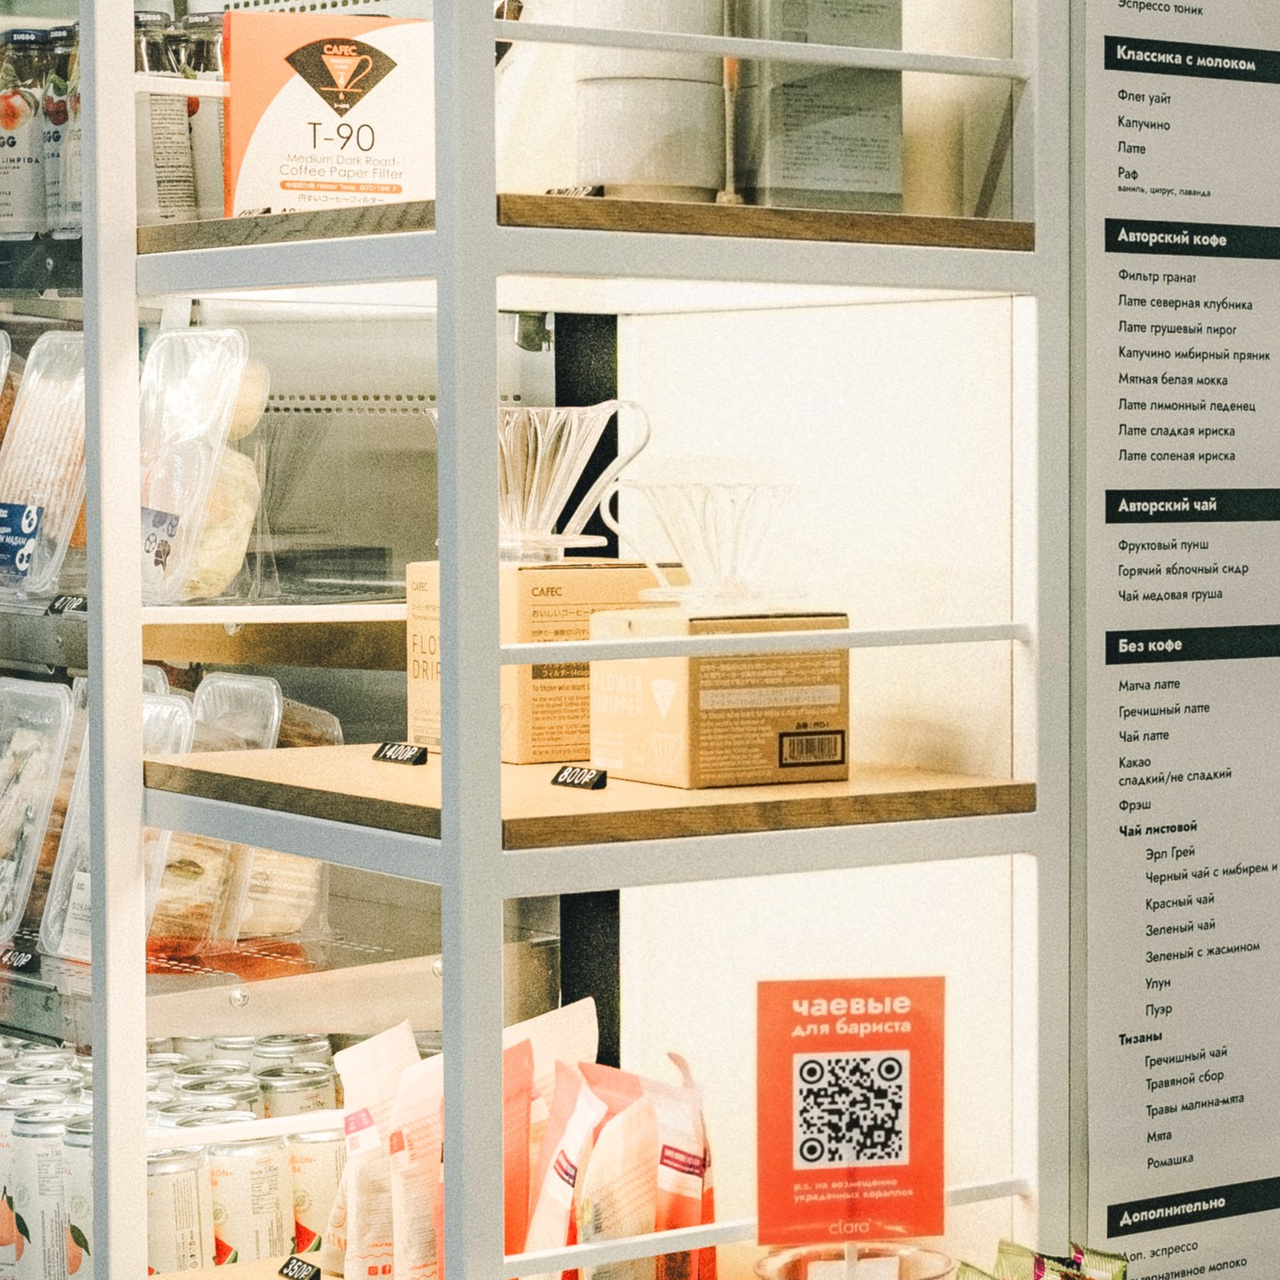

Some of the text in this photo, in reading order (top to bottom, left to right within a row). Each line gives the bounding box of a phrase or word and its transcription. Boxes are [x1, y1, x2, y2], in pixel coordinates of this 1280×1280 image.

[323, 44, 358, 56] CAFEC
[1116, 45, 1183, 65] Классика
[1185, 55, 1193, 66] с
[1196, 56, 1257, 71] молоком
[1117, 88, 1146, 103] Флет
[1148, 92, 1172, 106] уайт
[1117, 115, 1171, 132] Капучино
[307, 121, 375, 152] T-90
[336, 155, 362, 166] Dark
[279, 164, 405, 180] Coffee Paper Filter
[1118, 497, 1190, 514] Авторский
[1193, 497, 1217, 511] чай
[1117, 538, 1178, 554] Фруктовый
[1180, 541, 1210, 553] пунш
[1117, 563, 1163, 580] Горячий
[1165, 562, 1219, 576] яблочный
[1221, 564, 1250, 576] сидр
[531, 586, 562, 598] CAFEC
[1117, 589, 1140, 603] Чай
[1141, 590, 1189, 602] медовая
[1190, 589, 1224, 603] груша
[792, 995, 912, 1016] чаевые
[791, 1017, 912, 1038] для бариста
[1118, 1032, 1163, 1046] Тизаны
[1119, 1197, 1226, 1227] Дополнительно
